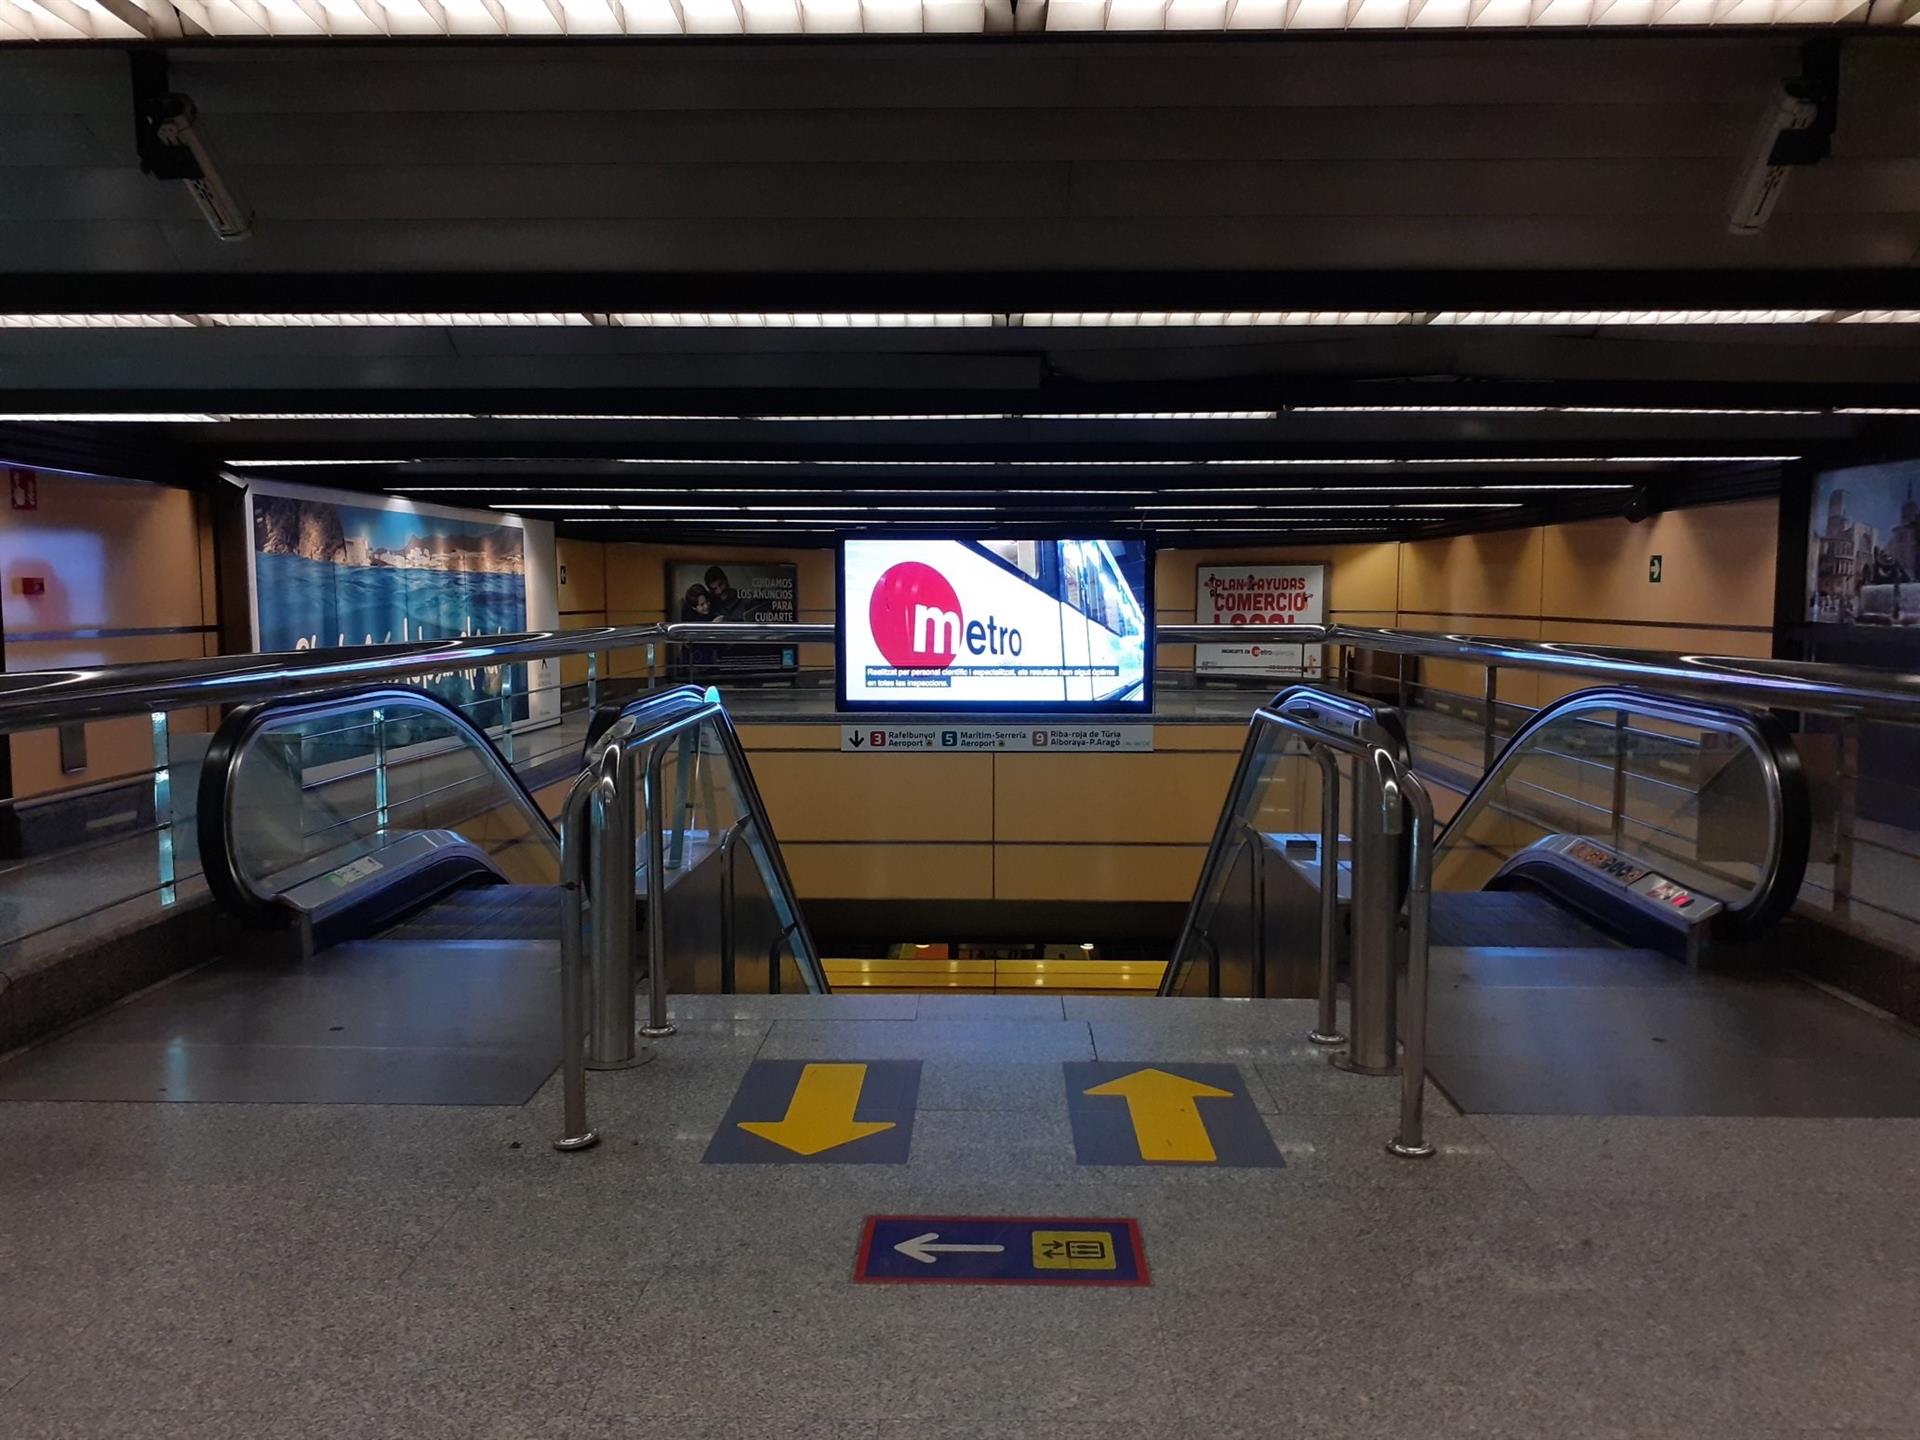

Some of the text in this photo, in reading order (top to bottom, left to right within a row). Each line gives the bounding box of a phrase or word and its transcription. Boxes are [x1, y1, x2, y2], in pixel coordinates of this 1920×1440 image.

[752, 578, 793, 588] CUIDAMOS
[1215, 577, 1306, 591] PLAN AYUDAS
[753, 589, 793, 599] ANUNCIOS
[771, 600, 793, 611] PARA
[1214, 592, 1306, 611] COMERCIO
[754, 612, 793, 623] CUIDARTE
[913, 603, 1022, 656] metro
[873, 731, 936, 745] 3 Rafelbunyol
[945, 732, 953, 745] 5
[1037, 731, 1045, 744] 9
[1051, 730, 1087, 740] Riba-roja
[1089, 730, 1099, 739] de
[888, 740, 923, 748] Aeroport
[961, 740, 995, 748] Aeroport
